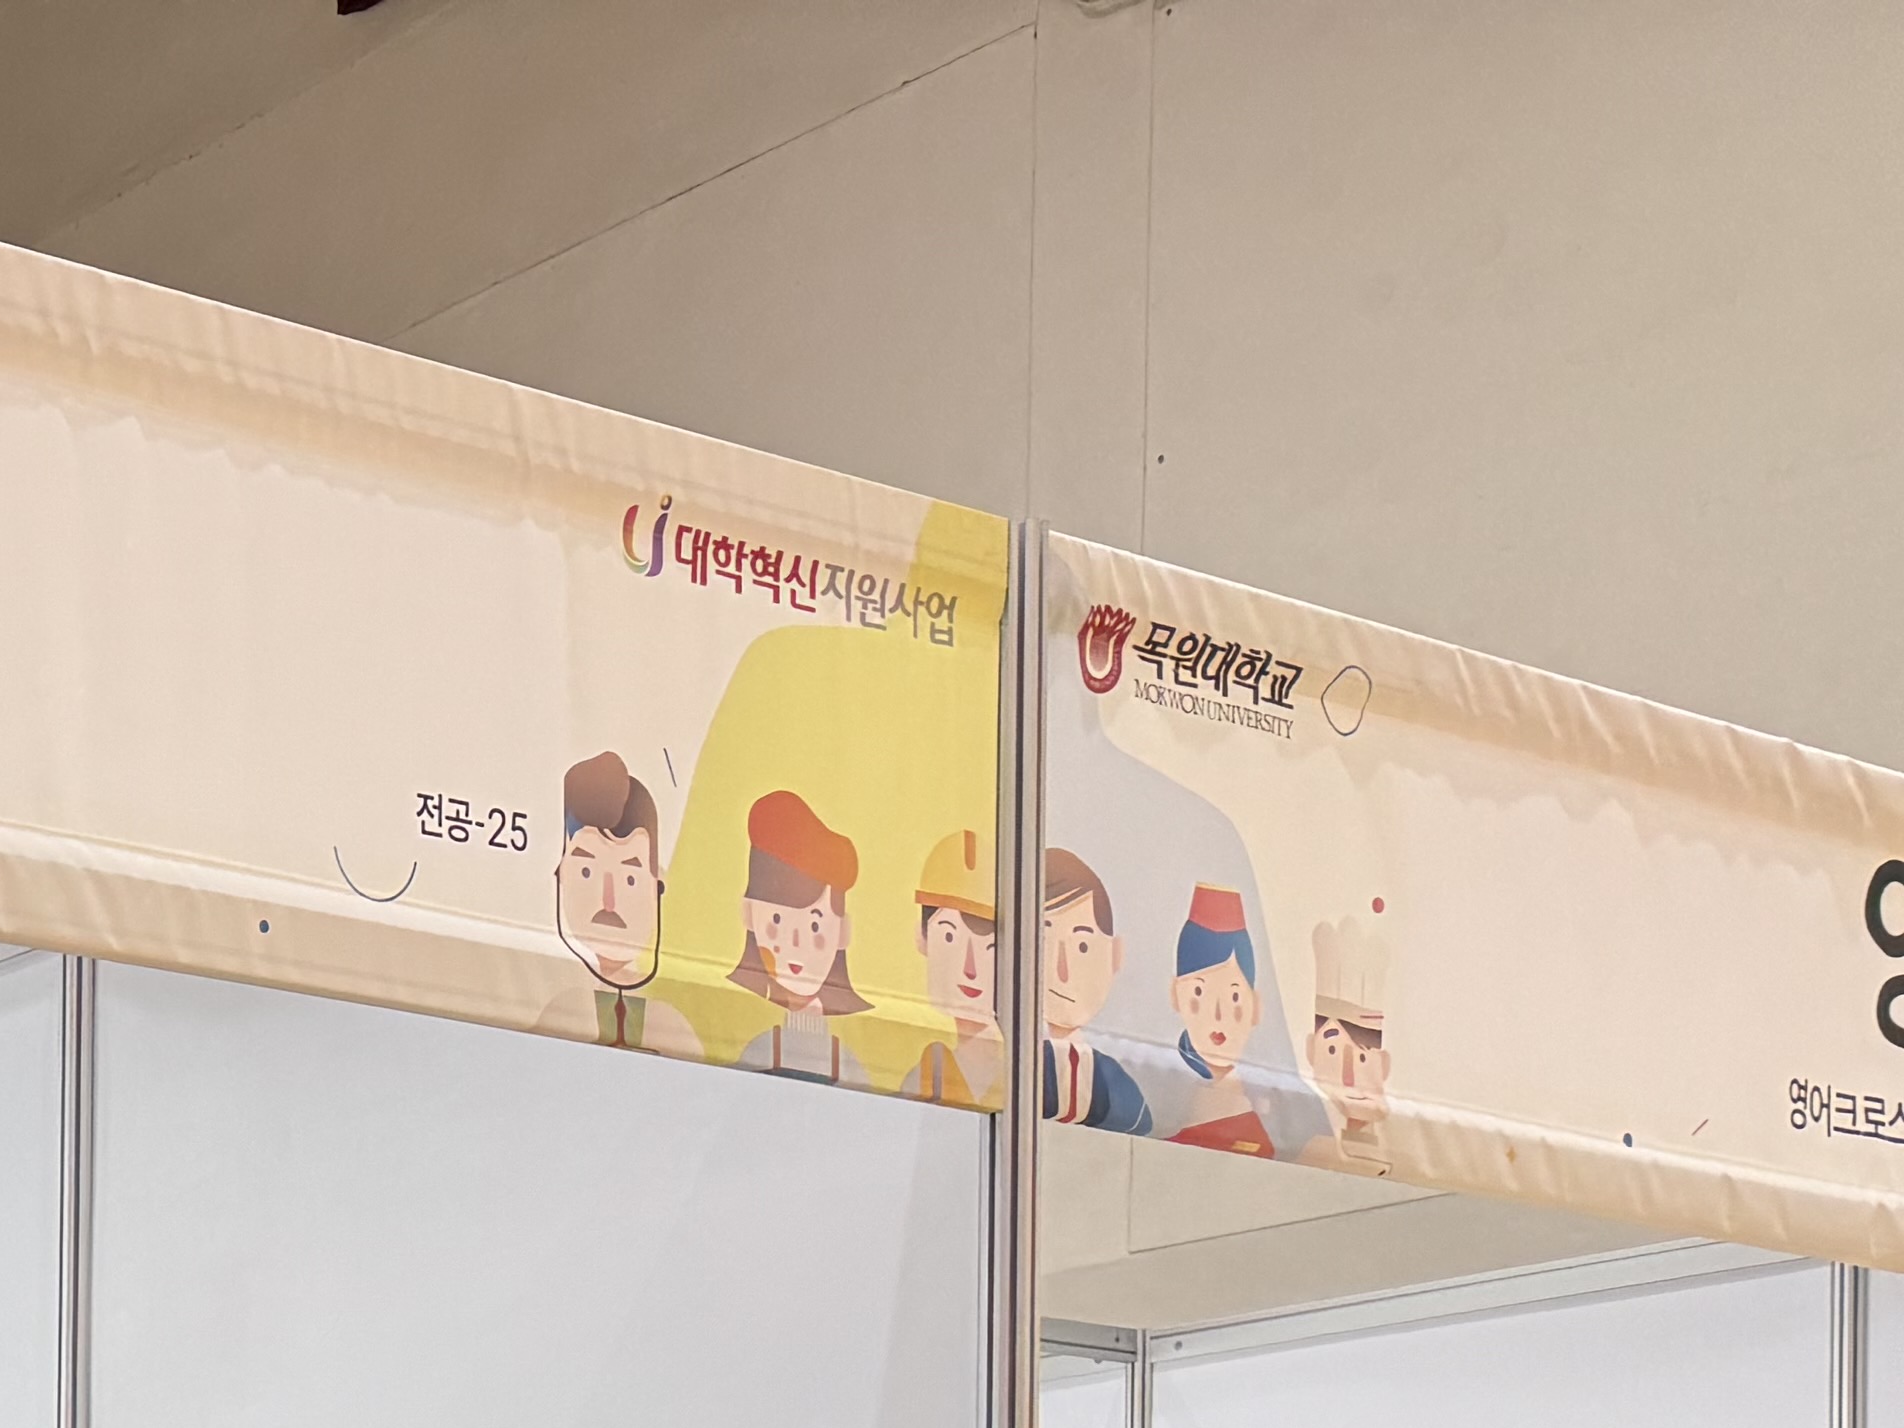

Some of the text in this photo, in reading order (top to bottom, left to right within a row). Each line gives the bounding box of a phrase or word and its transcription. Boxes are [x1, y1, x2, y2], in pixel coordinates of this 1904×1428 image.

[675, 523, 957, 646] 대학혁신지원사업
[1133, 622, 1303, 709] 목원대학교
[1134, 679, 1294, 739] MOKWON UNIVERSITY
[415, 791, 528, 852] 전공-25
